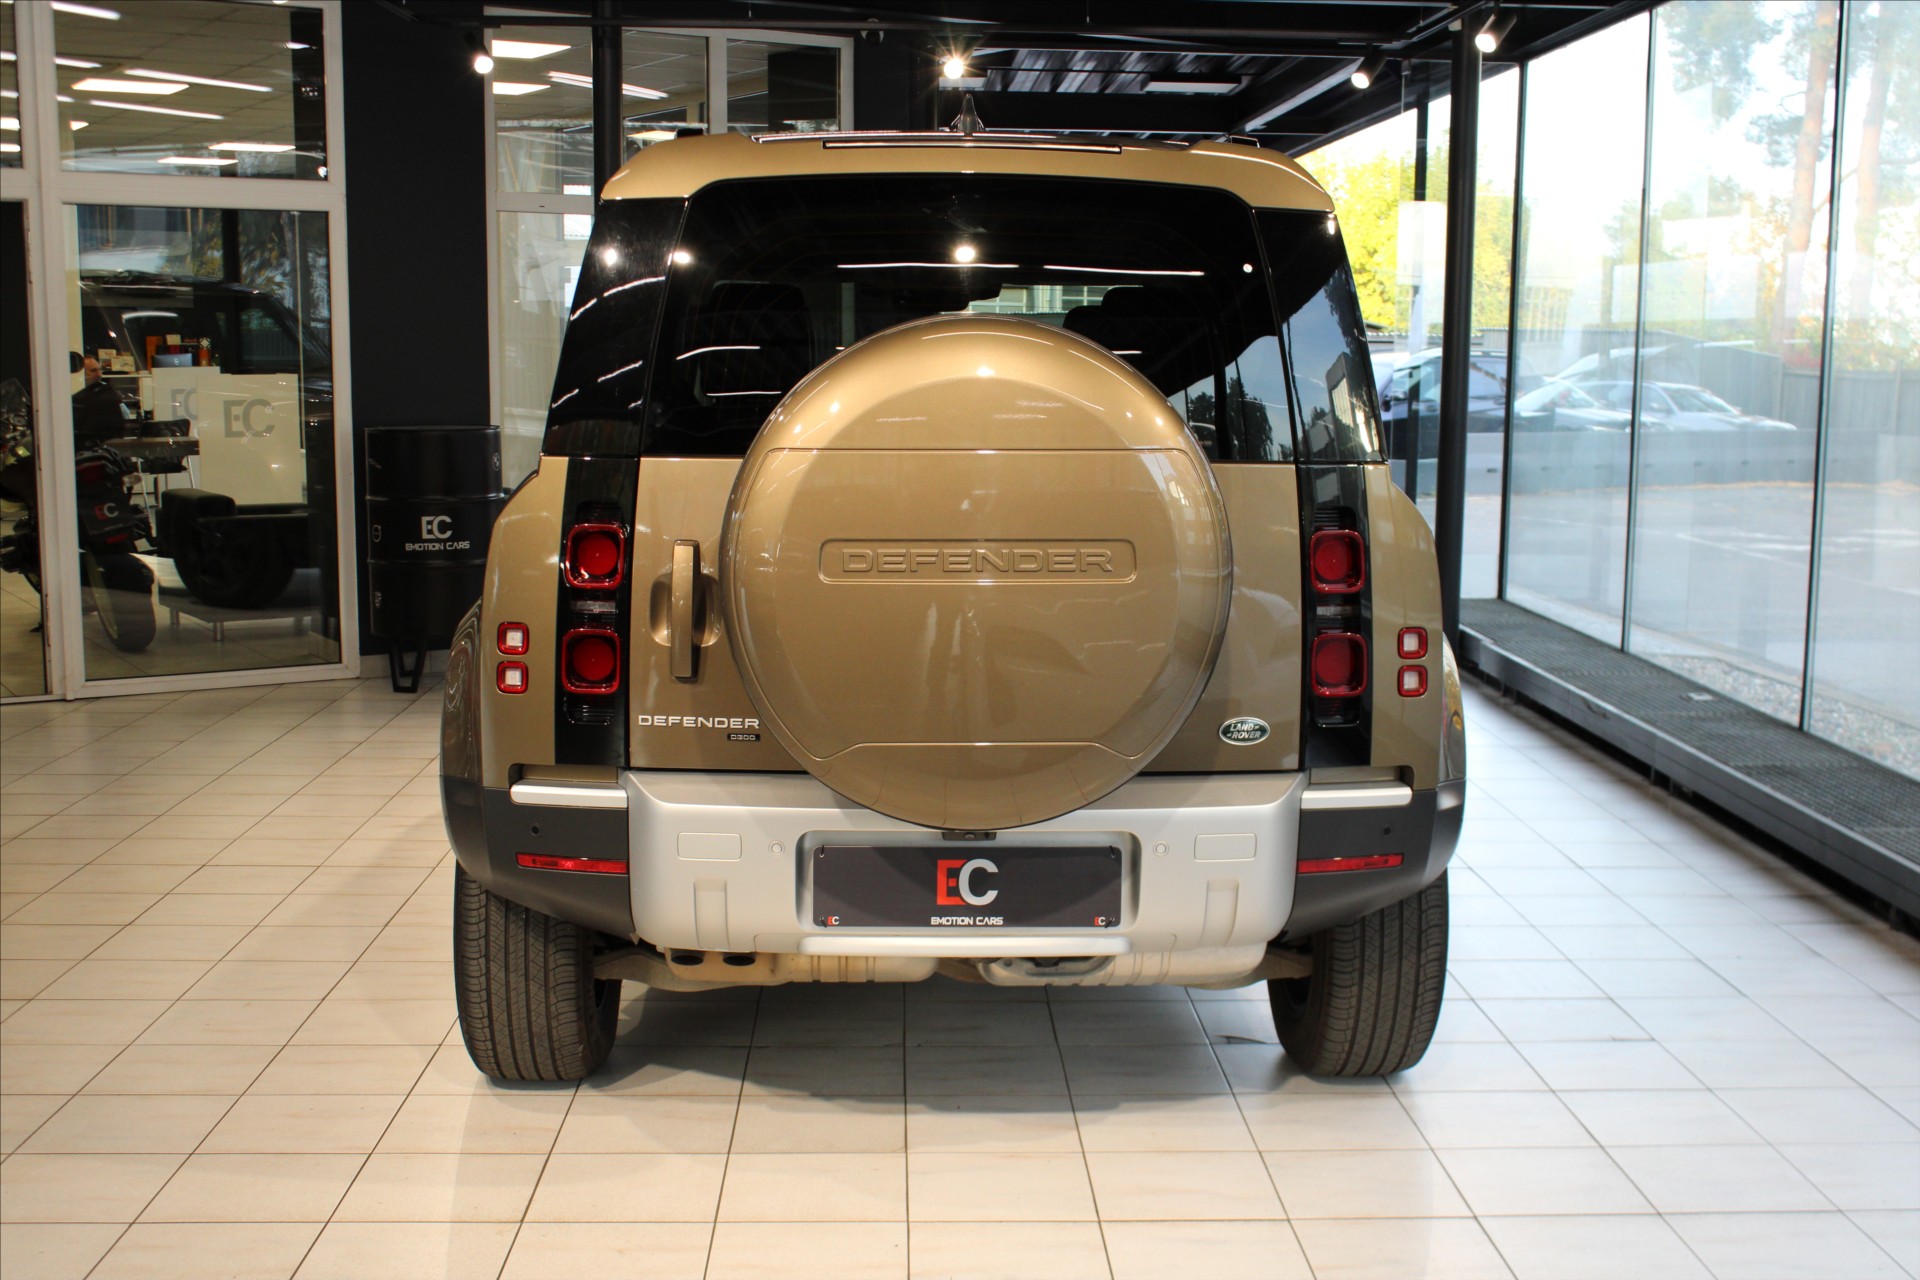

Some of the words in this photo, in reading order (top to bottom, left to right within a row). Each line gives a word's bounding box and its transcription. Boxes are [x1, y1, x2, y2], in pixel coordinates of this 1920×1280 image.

[223, 398, 276, 438] EC
[421, 515, 453, 540] EC
[405, 542, 444, 551] EMOTION
[446, 541, 471, 550] CARS
[842, 549, 1113, 572] DEFENDER
[638, 714, 760, 729] DEFENDER
[1230, 723, 1255, 731] LAND
[1231, 731, 1261, 739] ROVER
[937, 858, 999, 906] EC
[931, 916, 974, 925] EMOTION
[976, 916, 1004, 925] CARS
